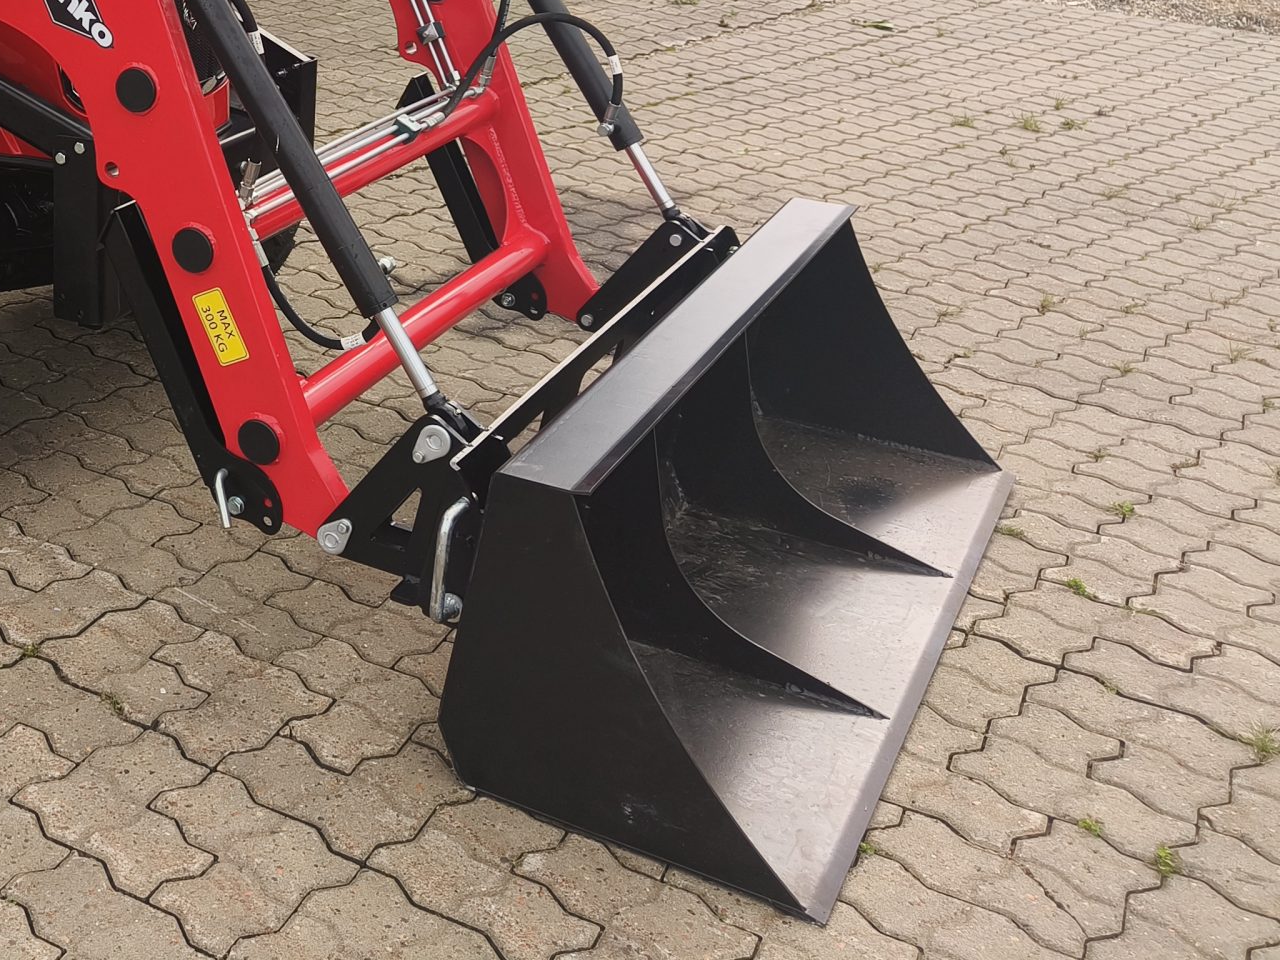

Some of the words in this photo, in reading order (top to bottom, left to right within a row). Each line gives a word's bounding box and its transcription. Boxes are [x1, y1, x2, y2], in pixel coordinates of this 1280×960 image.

[201, 305, 218, 330] 300
[213, 333, 228, 353] KG
[216, 309, 235, 339] MAX
